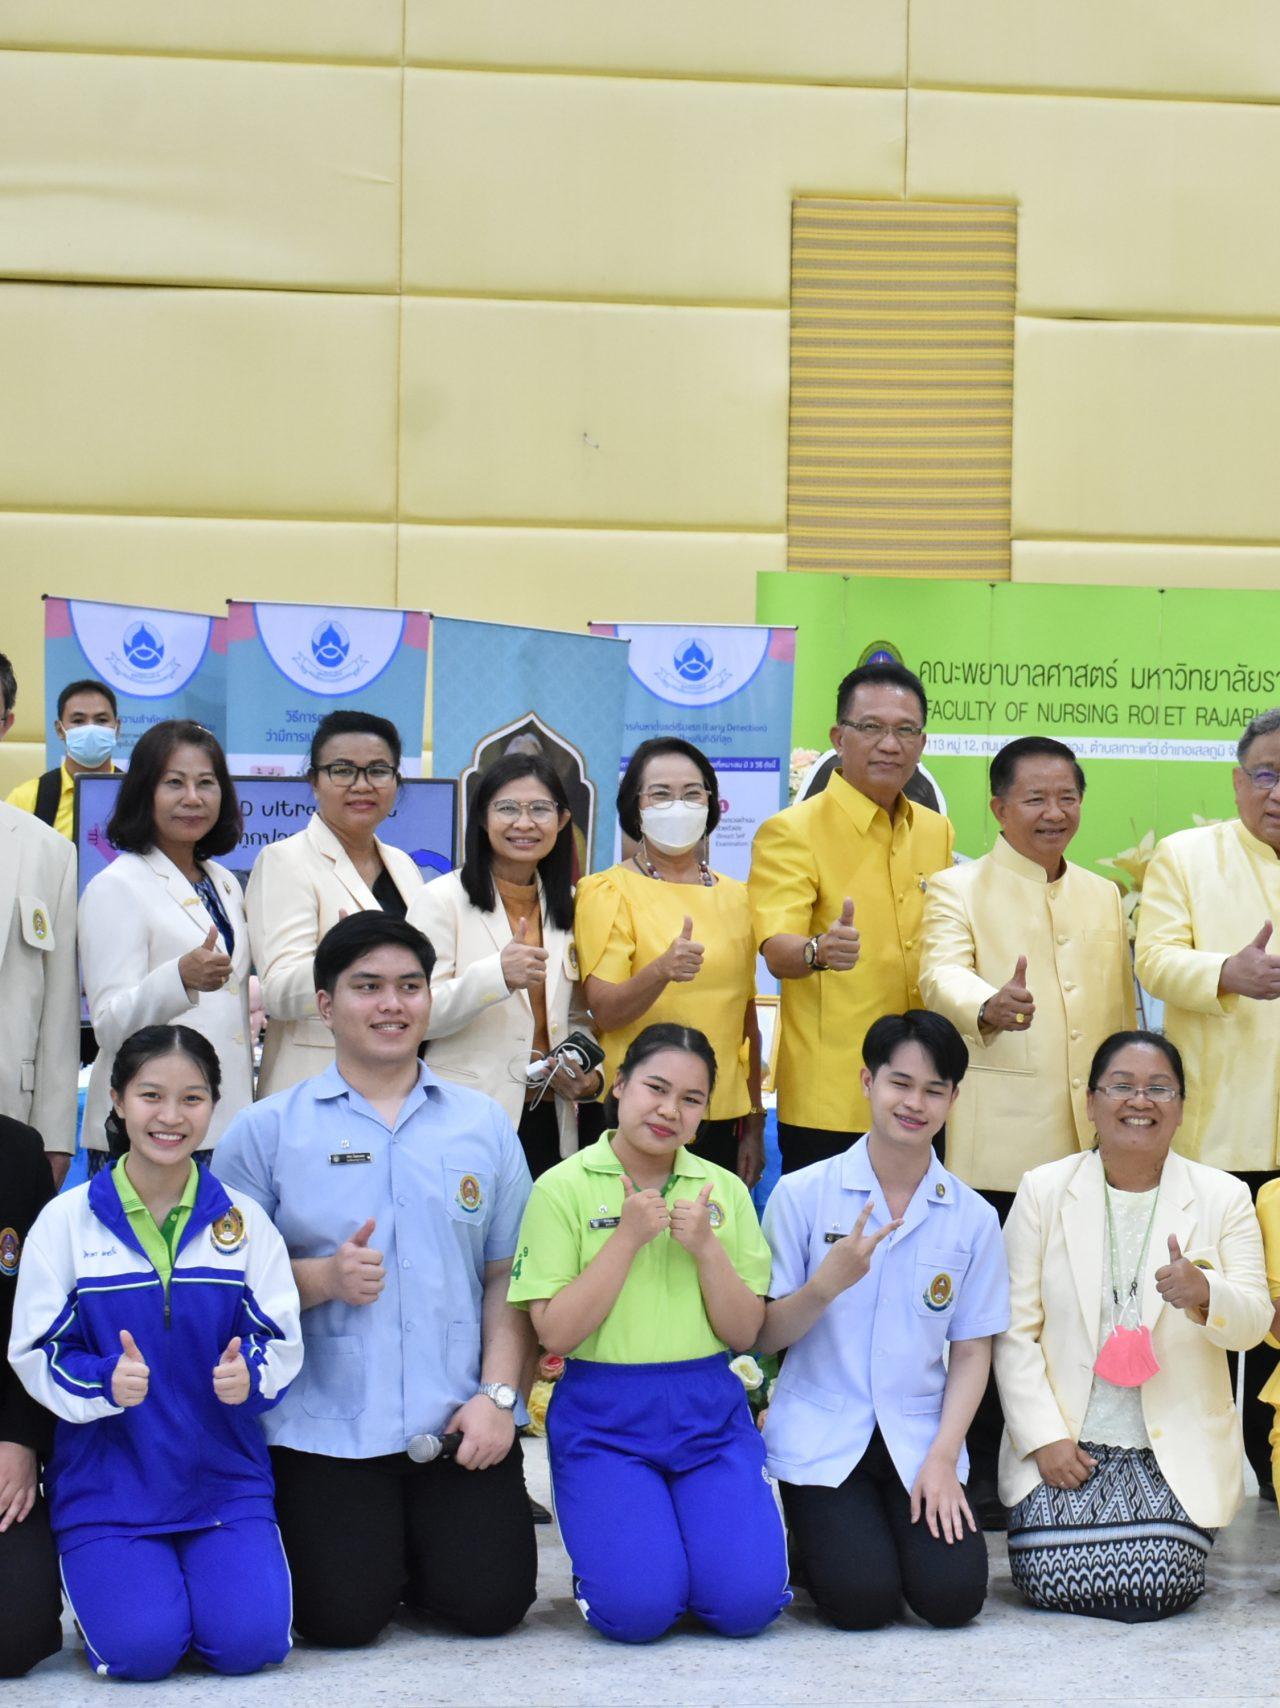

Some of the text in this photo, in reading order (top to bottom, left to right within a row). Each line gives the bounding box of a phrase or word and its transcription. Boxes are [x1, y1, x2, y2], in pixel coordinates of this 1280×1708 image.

[919, 658, 1119, 690] คณะพยาบาลศาสตร์
[1005, 701, 1029, 722] OF
[1037, 702, 1119, 725] NURSING
